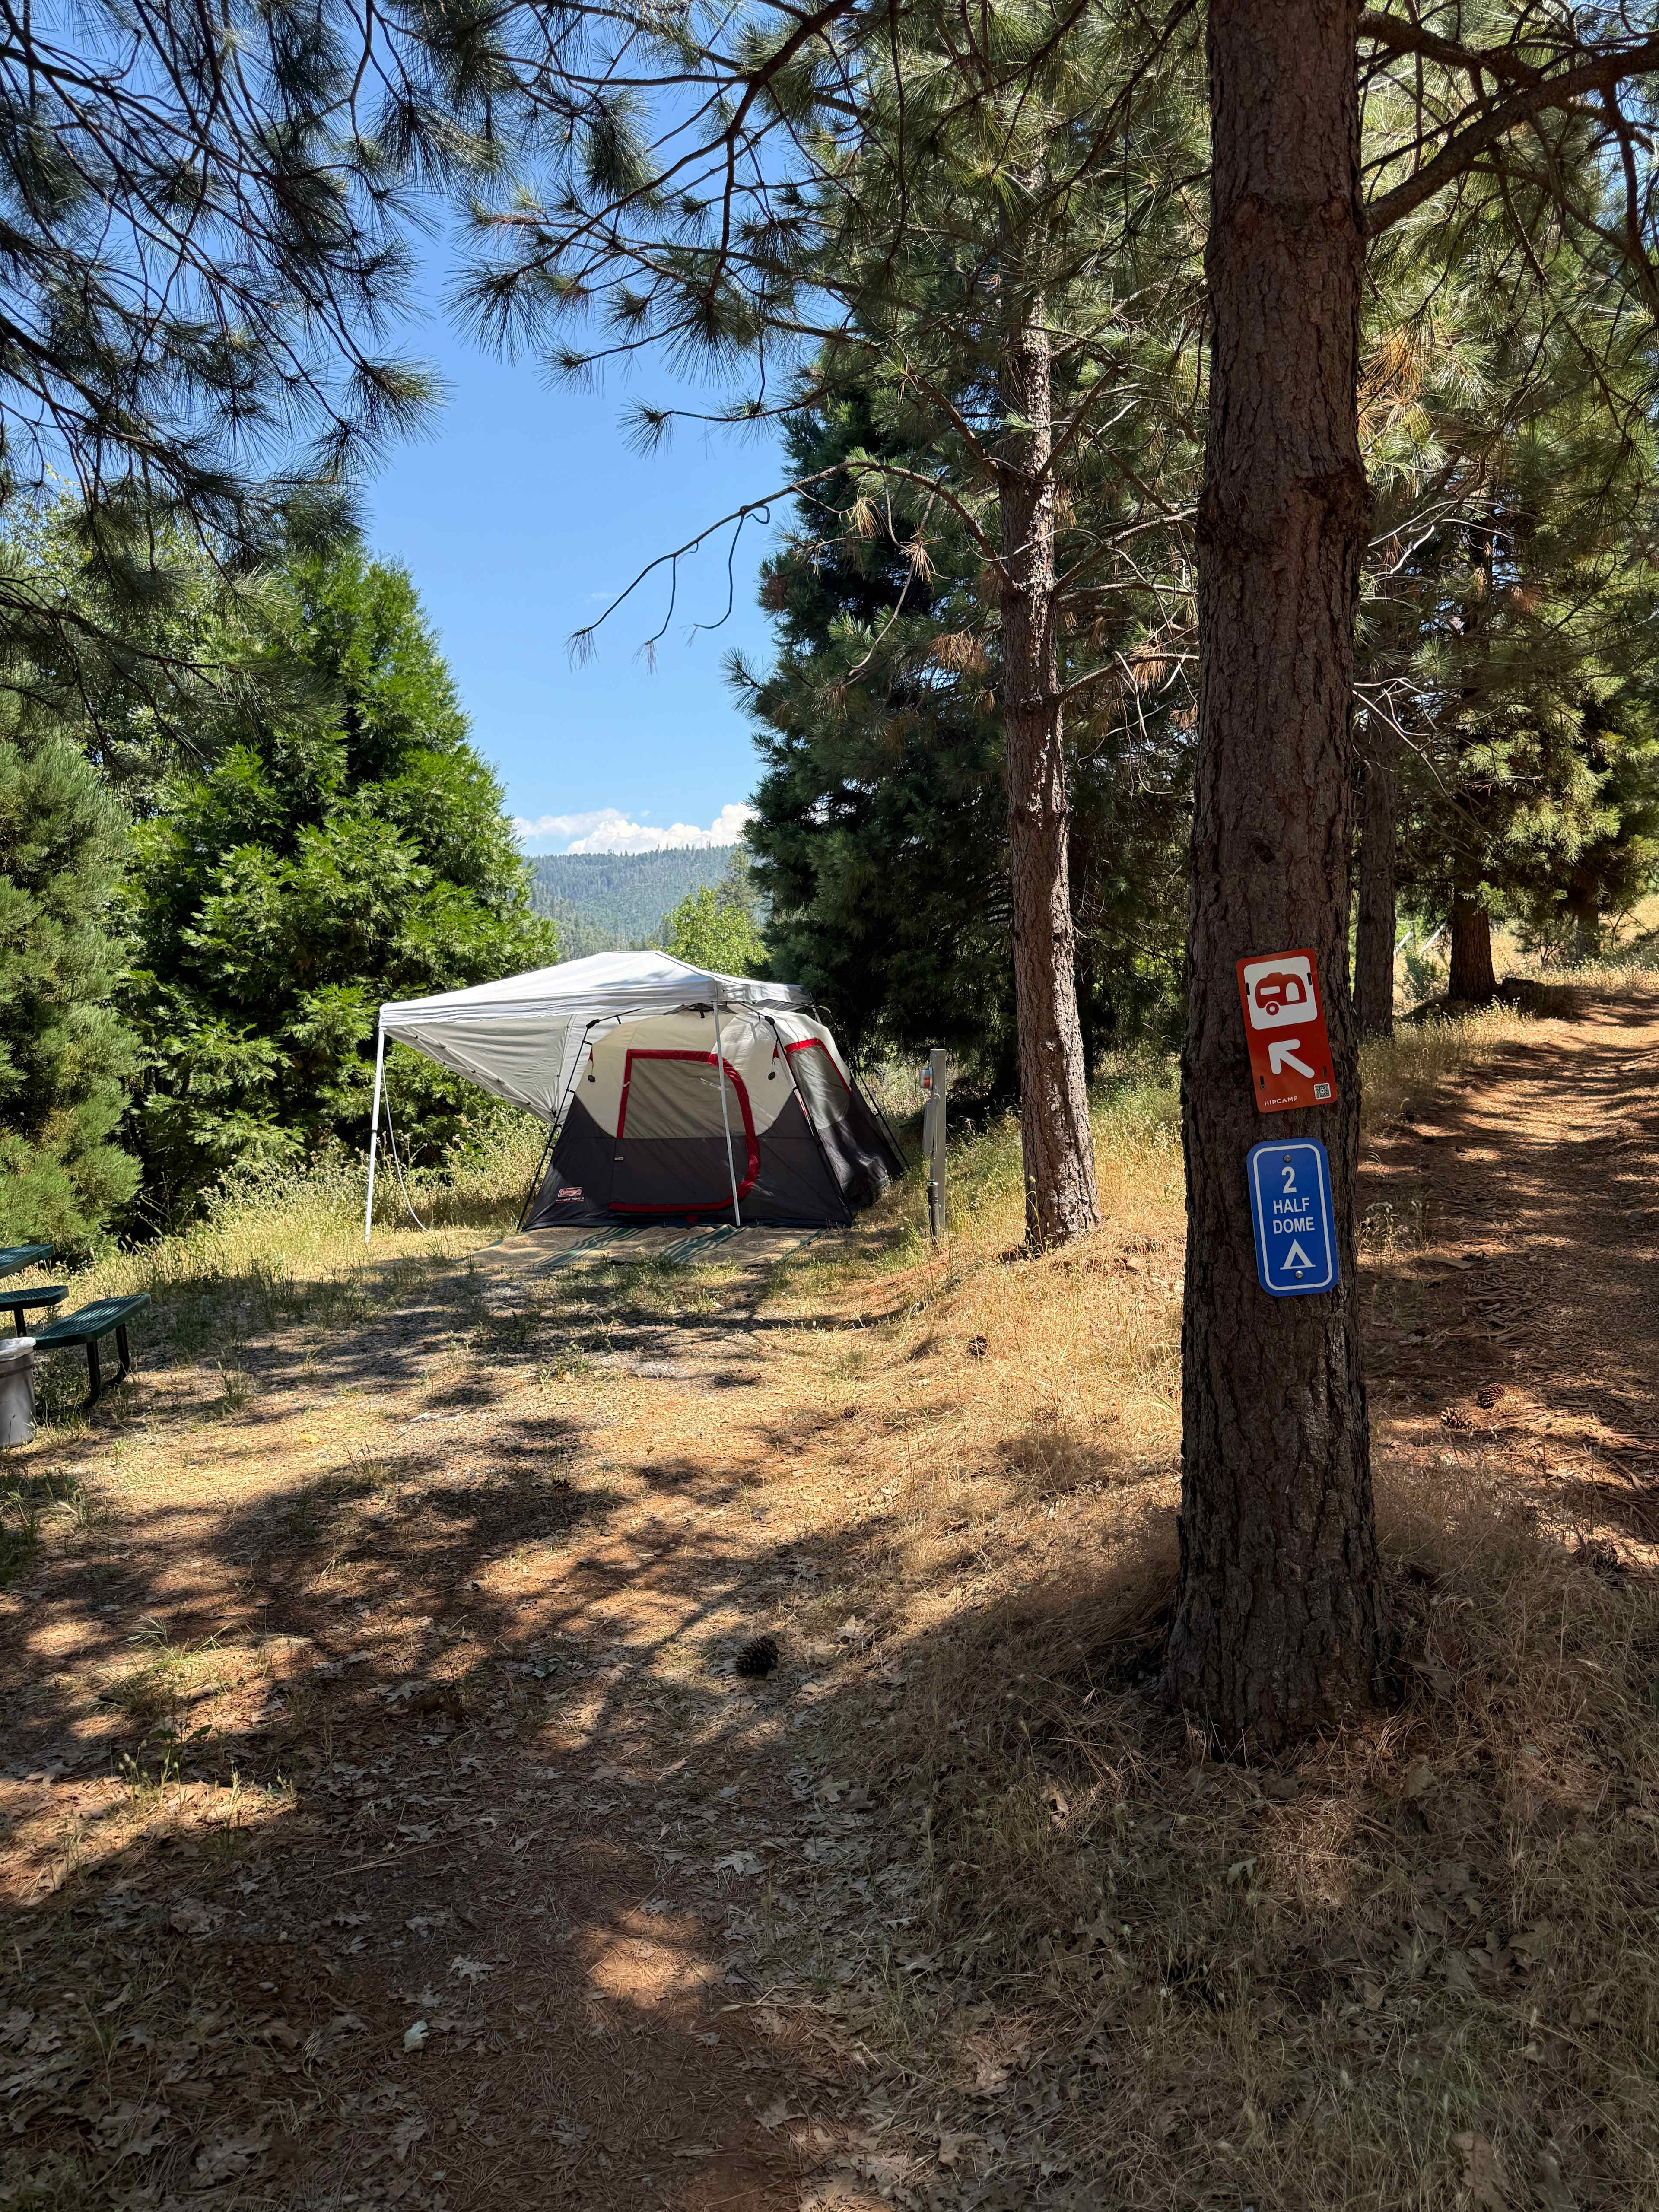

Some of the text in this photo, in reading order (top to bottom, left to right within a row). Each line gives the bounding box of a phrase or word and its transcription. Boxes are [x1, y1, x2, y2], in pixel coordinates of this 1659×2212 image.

[1264, 1096, 1298, 1106] HIPCAMP
[1281, 1166, 1297, 1193] 2
[1273, 1197, 1309, 1214] HALF
[1273, 1217, 1315, 1234] DOME
